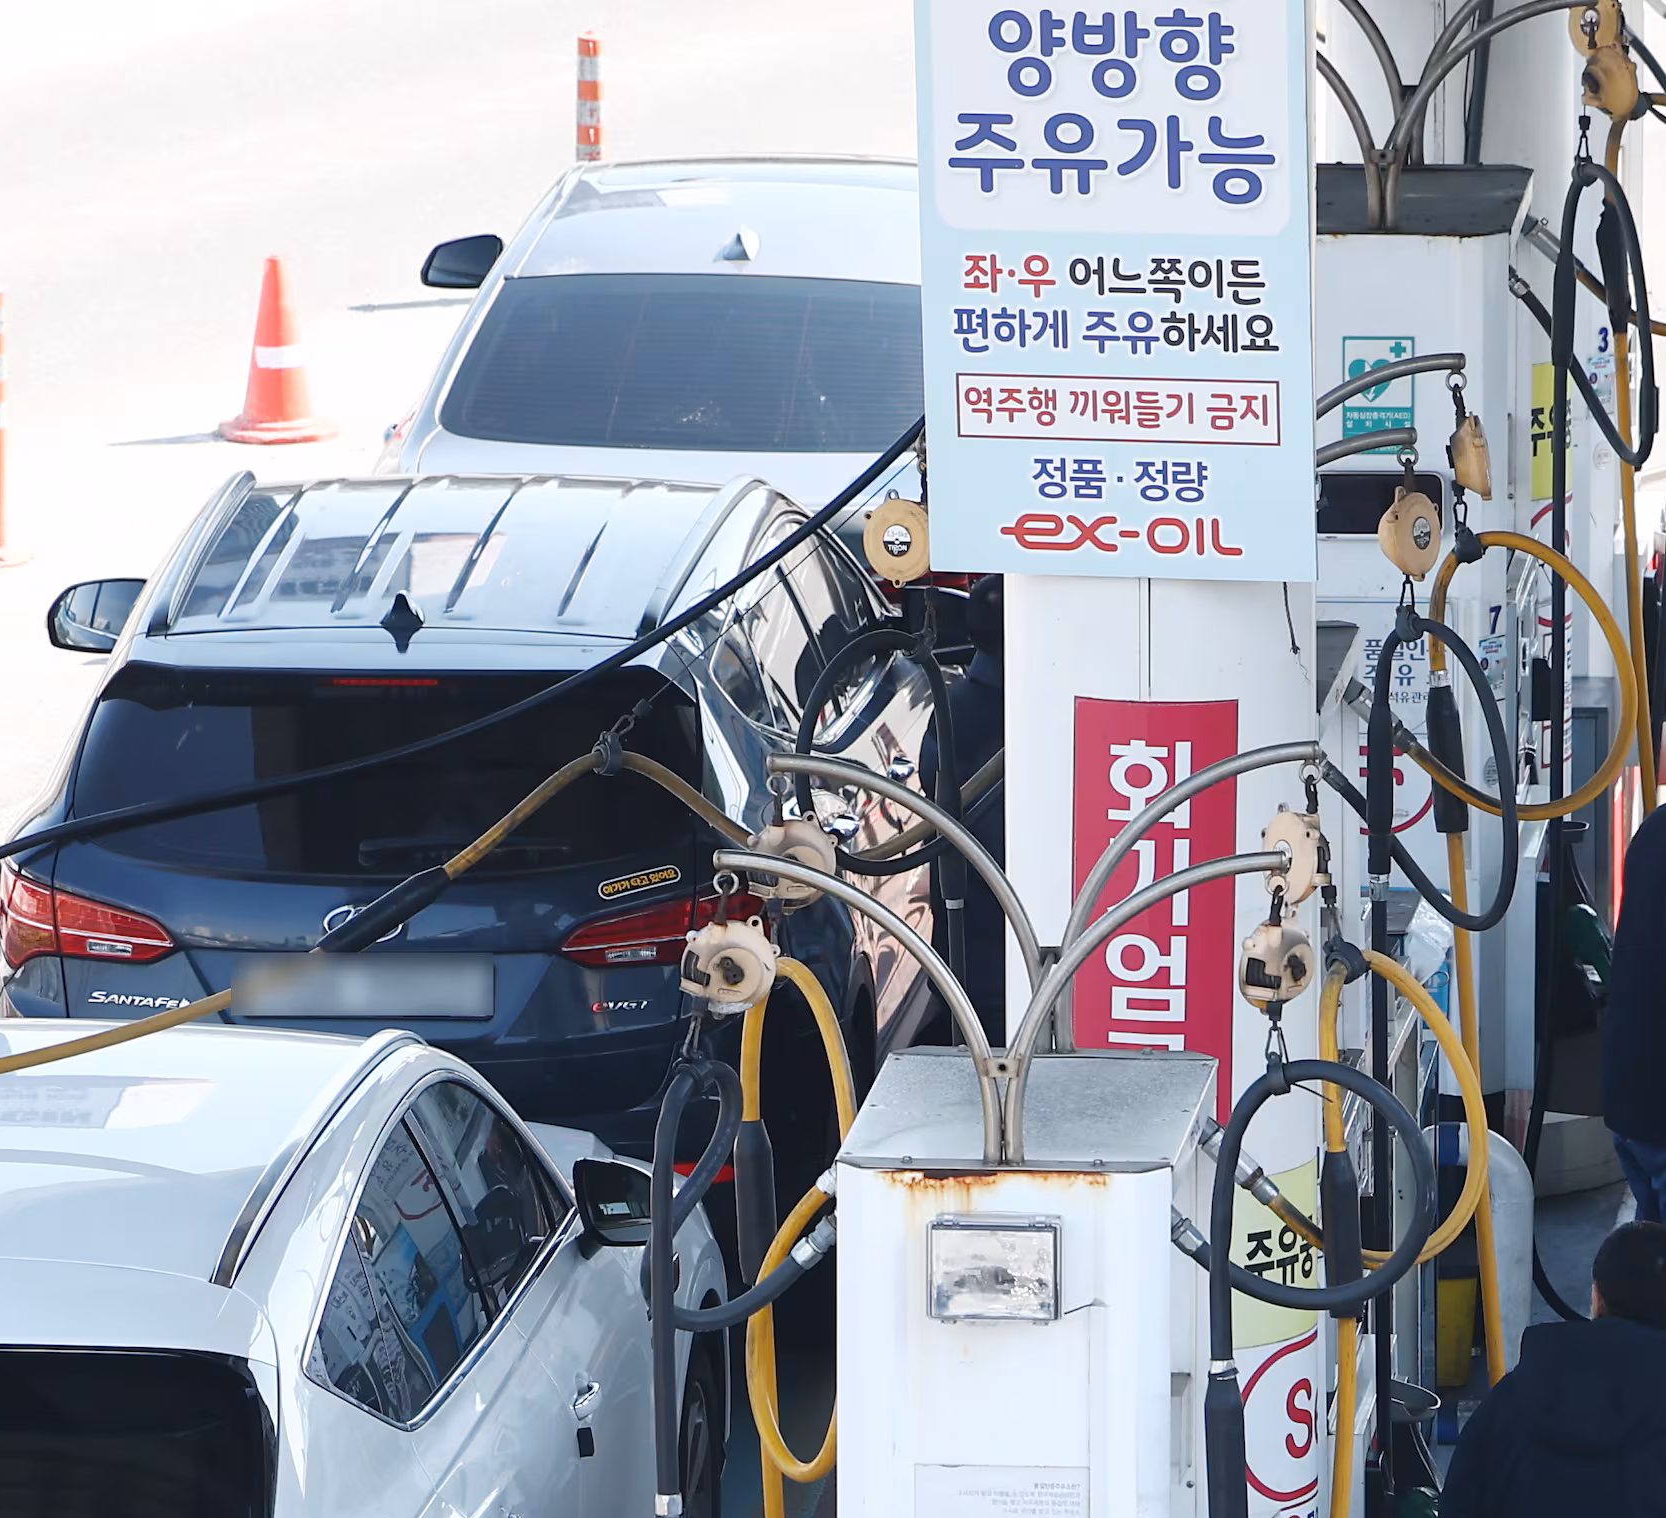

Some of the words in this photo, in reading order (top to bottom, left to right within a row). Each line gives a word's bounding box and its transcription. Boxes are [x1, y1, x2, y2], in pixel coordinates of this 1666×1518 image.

[988, 8, 1235, 102] 양방향
[948, 112, 1276, 204] 주유가능
[963, 253, 1056, 298] 좌·우
[1068, 257, 1266, 305] 어느쪽이든
[953, 307, 1069, 353] 편하게
[1082, 310, 1280, 354] 주유하세요
[1598, 327, 1609, 353] 3
[964, 386, 1059, 426] 역주행
[1069, 388, 1196, 429] 끼워들기
[1206, 392, 1269, 432] 금지
[1489, 605, 1502, 635] 7
[1106, 739, 1193, 1051] 화기엄
